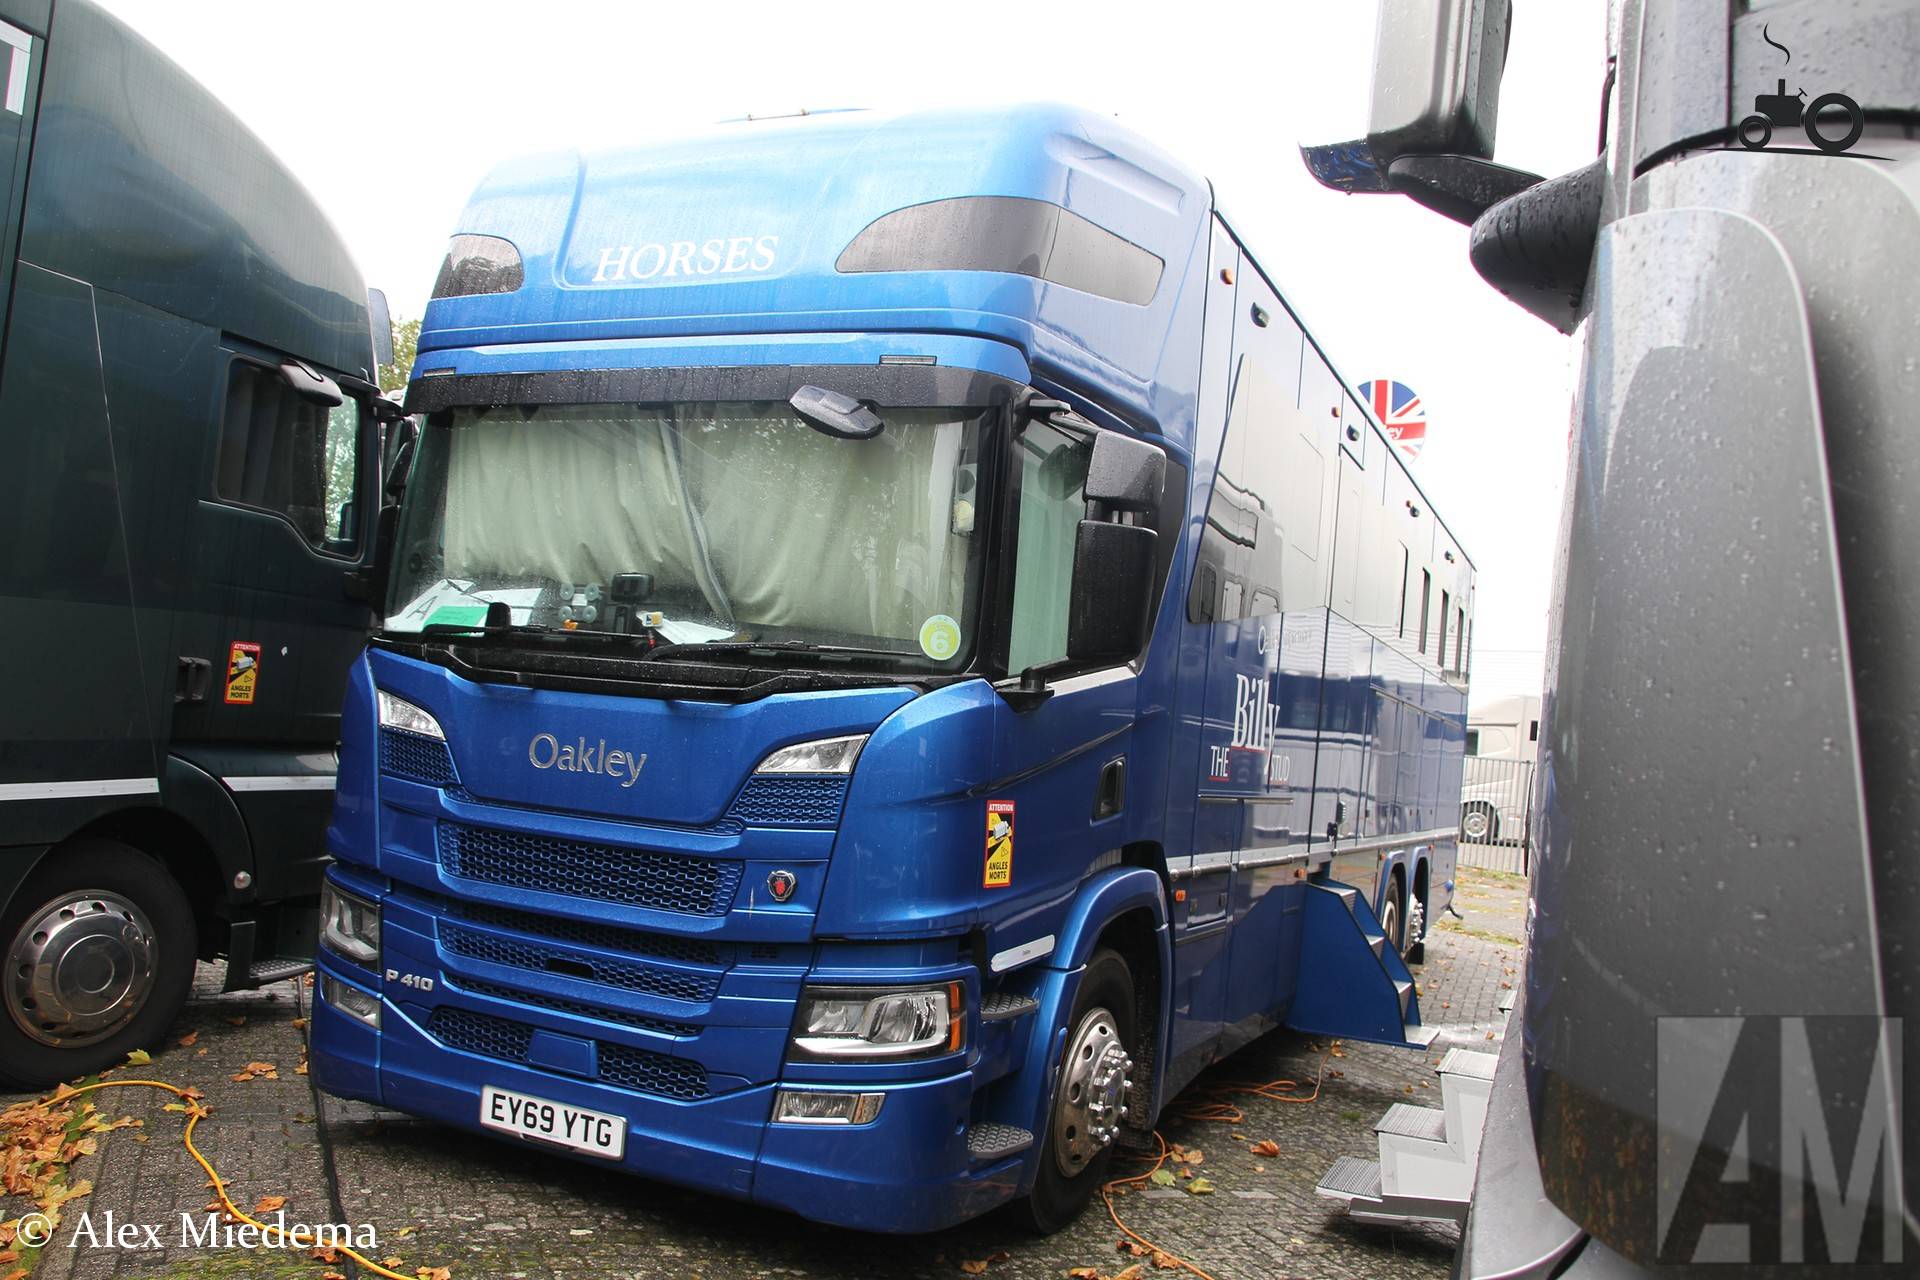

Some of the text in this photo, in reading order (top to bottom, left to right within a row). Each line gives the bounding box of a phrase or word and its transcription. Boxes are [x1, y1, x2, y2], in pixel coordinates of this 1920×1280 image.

[592, 235, 779, 282] HORSES
[234, 643, 260, 651] ATTENTION
[930, 631, 949, 653] 6
[1209, 746, 1229, 777] THE
[1231, 674, 1281, 775] Billy
[529, 733, 647, 787] Oakley
[989, 803, 1014, 812] ATTENTION
[988, 861, 1008, 870] ANGLES
[988, 871, 1007, 880] MORTS
[386, 969, 434, 991] P 410
[491, 1093, 612, 1147] EY69 YTG
